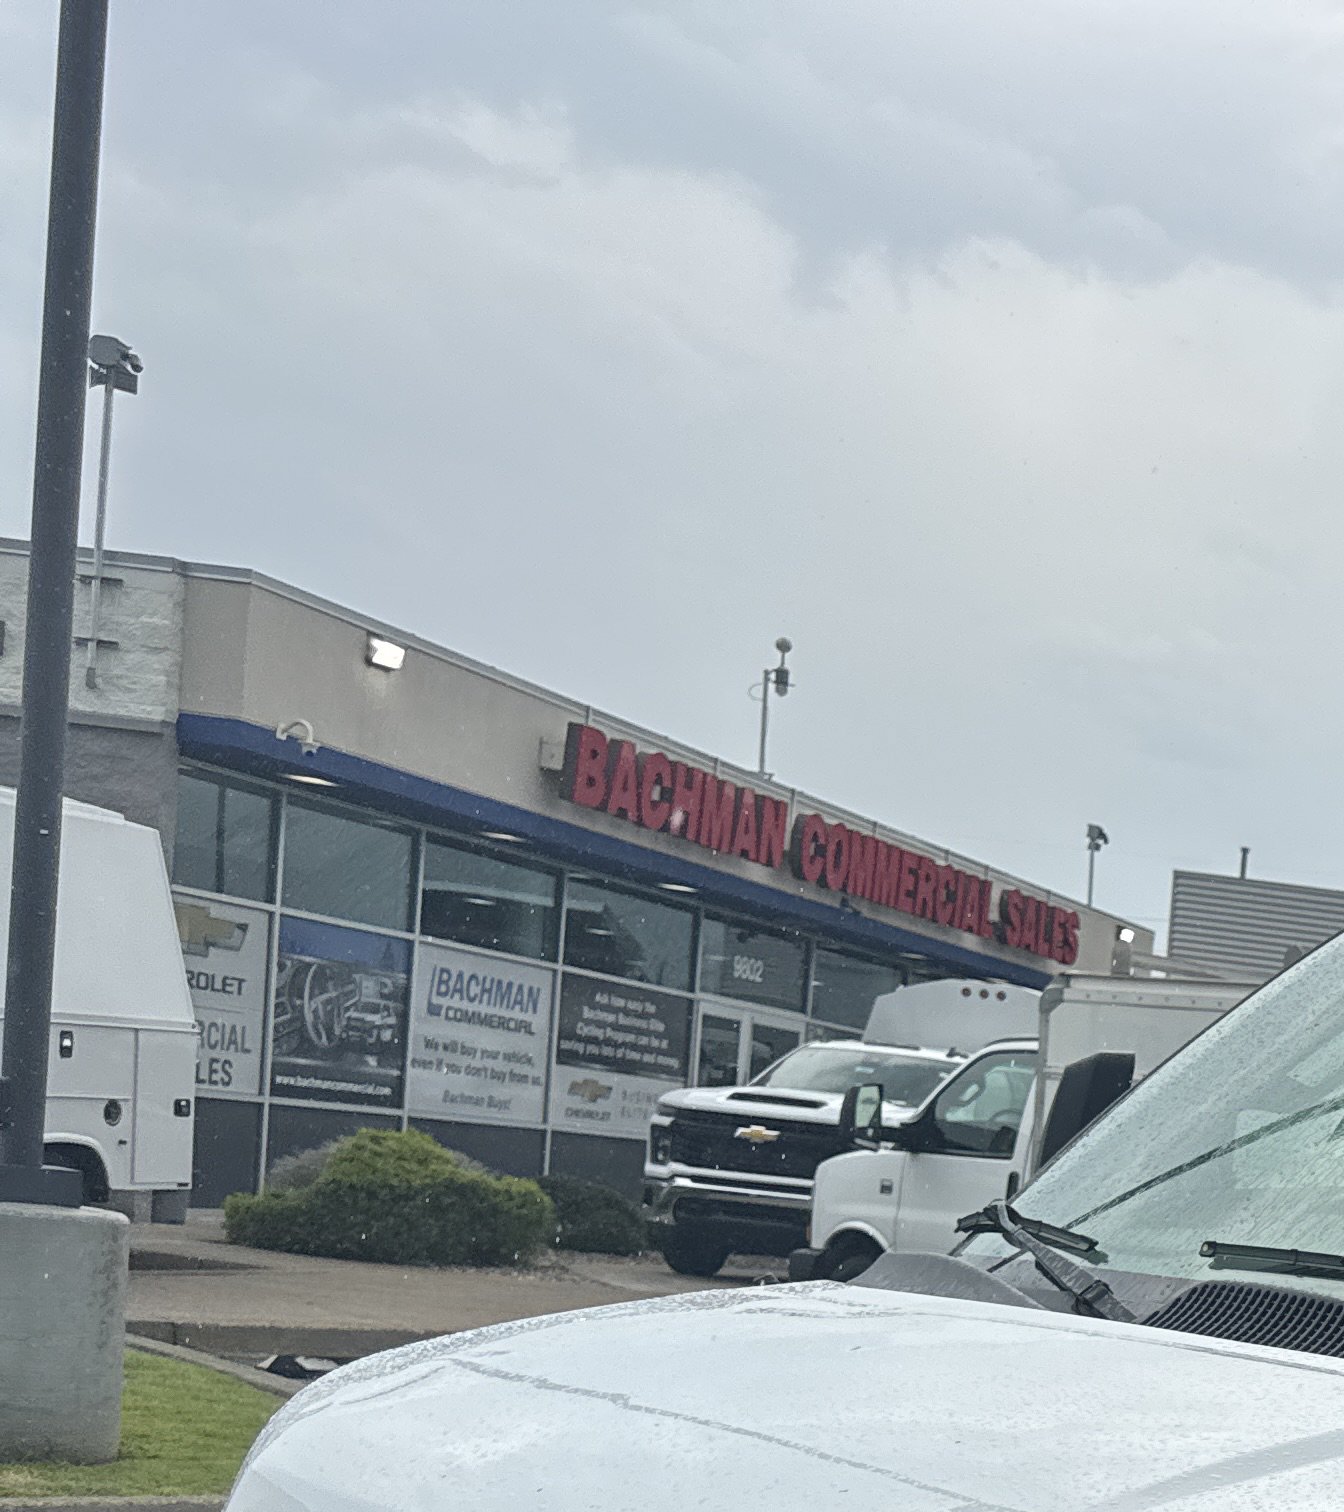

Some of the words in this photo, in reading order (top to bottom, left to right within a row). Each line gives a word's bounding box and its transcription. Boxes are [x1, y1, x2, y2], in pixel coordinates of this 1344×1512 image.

[572, 724, 789, 869] BACHMAN
[798, 814, 995, 938] COMMERCIAL
[1005, 889, 1082, 965] SALES
[436, 967, 541, 1015] BACHMAN
[445, 1006, 535, 1036] COMMERCIAL
